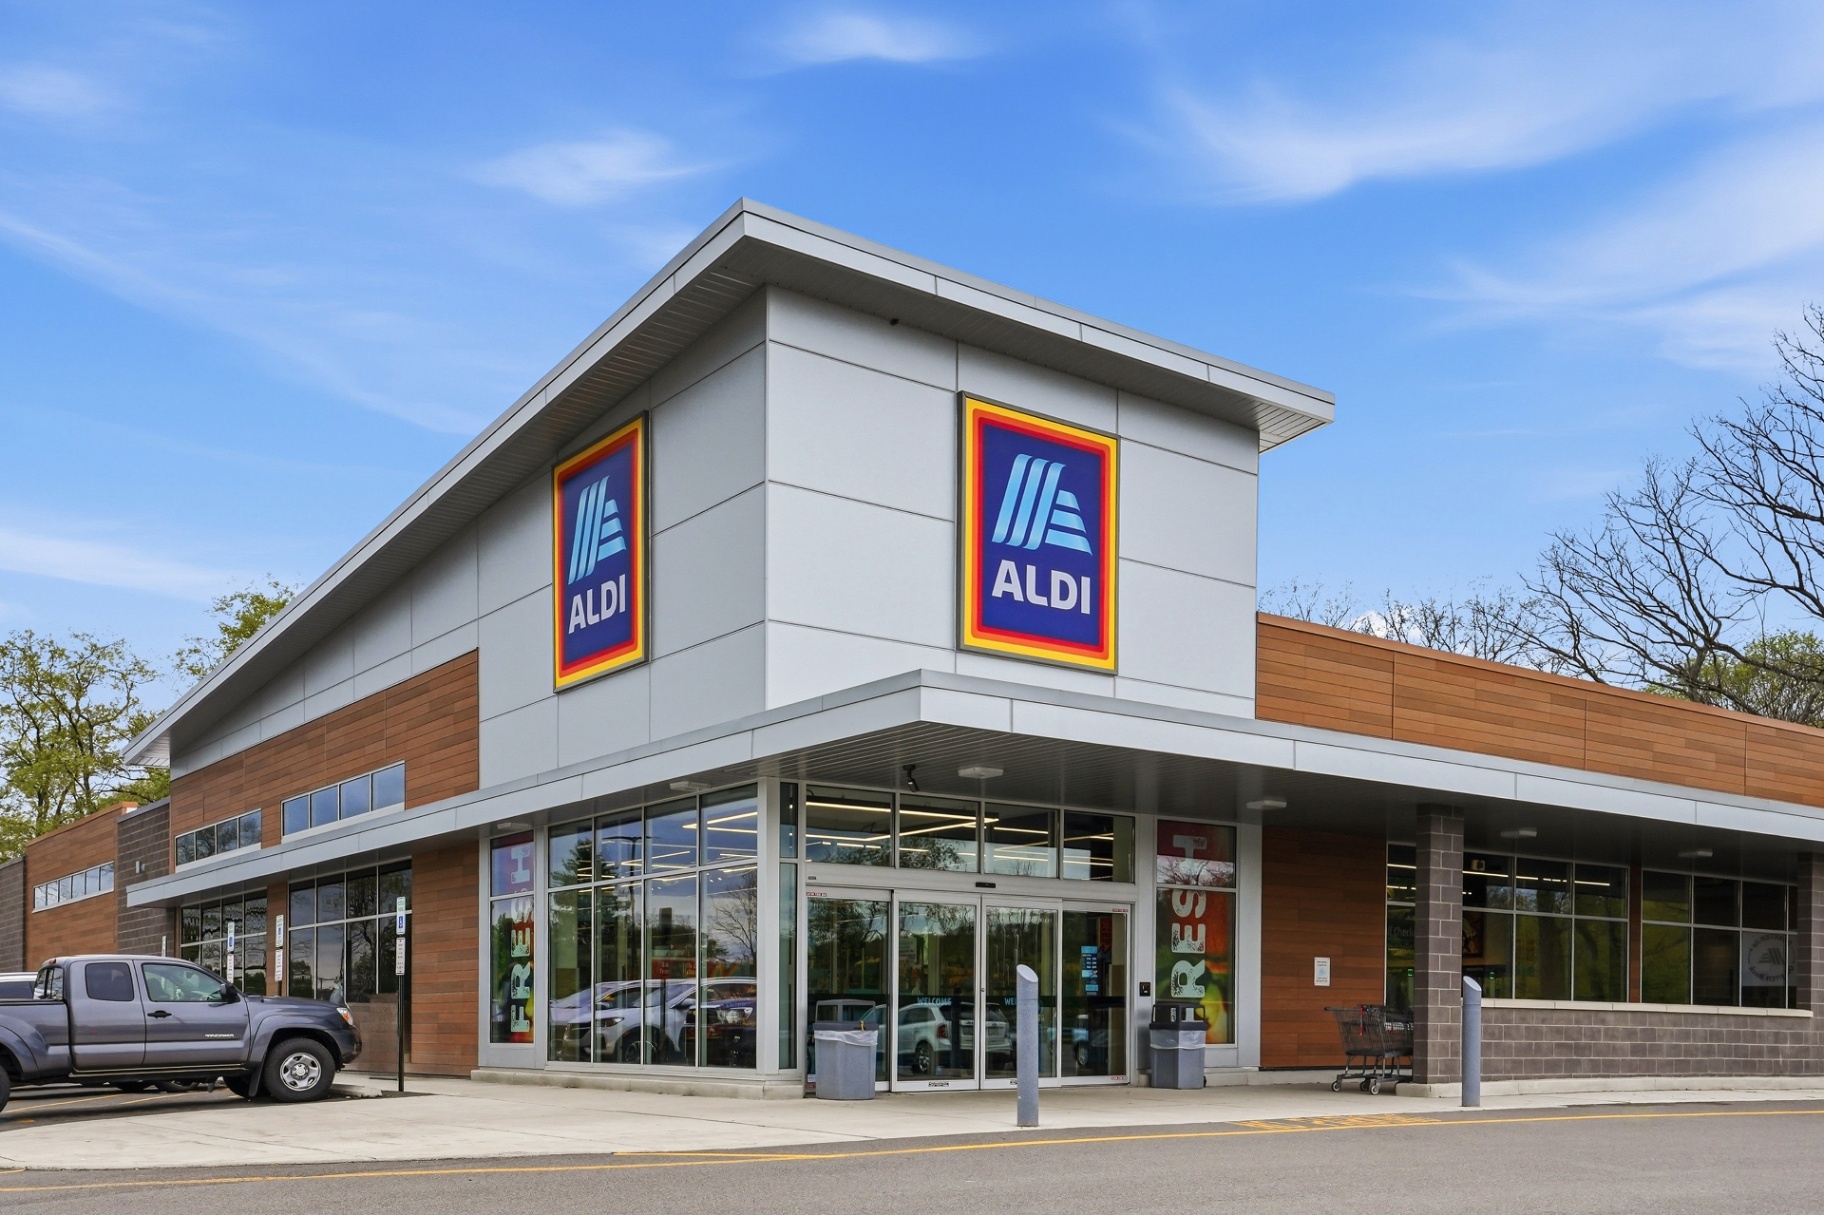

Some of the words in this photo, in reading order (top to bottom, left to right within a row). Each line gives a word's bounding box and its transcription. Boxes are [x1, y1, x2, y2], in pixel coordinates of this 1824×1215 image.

[568, 573, 626, 634] ALDI
[992, 559, 1090, 615] ALDI
[510, 846, 531, 1033] FRESH
